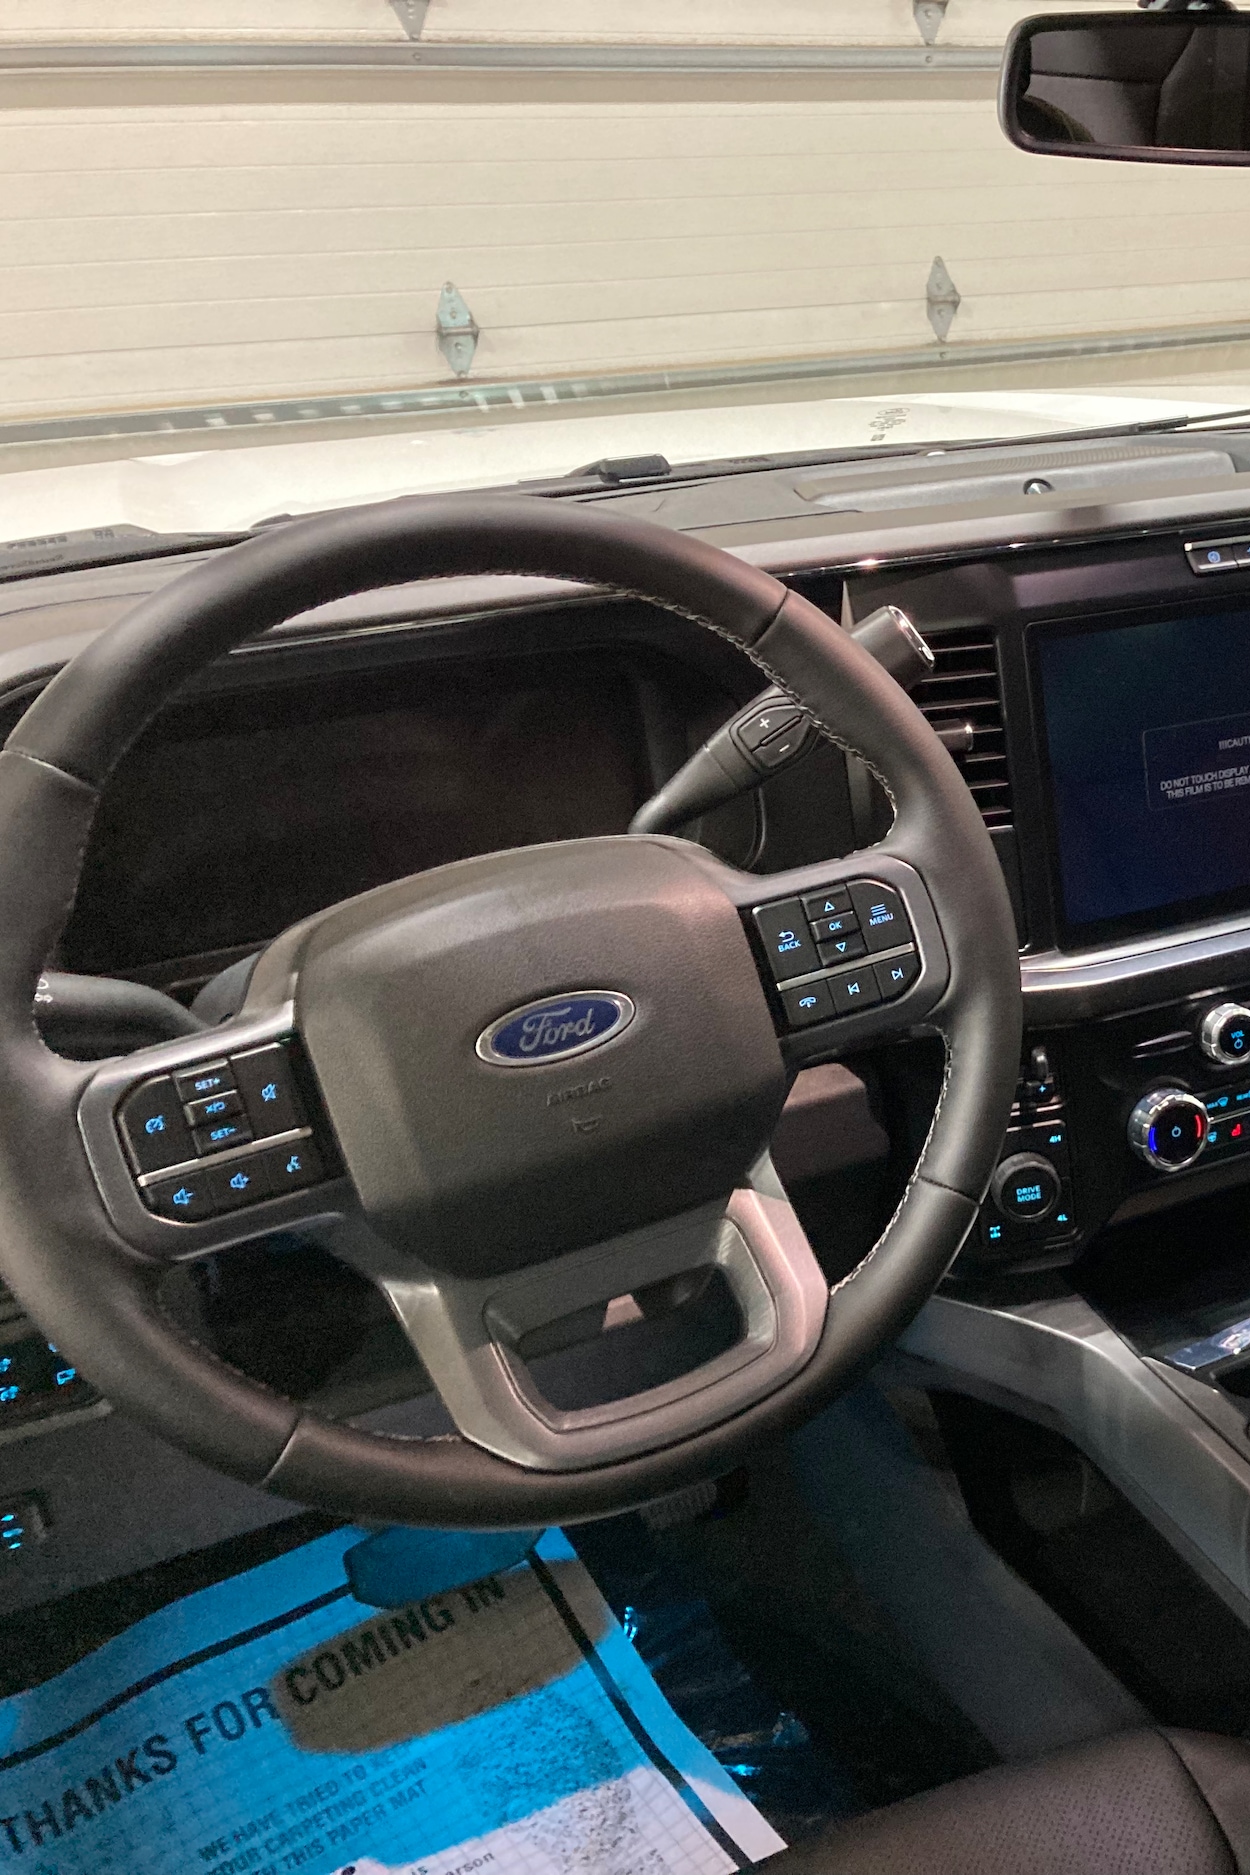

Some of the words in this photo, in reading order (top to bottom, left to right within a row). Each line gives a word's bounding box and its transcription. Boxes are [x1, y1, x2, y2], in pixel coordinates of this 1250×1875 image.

[1160, 781, 1173, 792] DO
[1173, 777, 1189, 788] NOT
[1192, 771, 1219, 785] TOUCH
[1218, 765, 1250, 779] DISPLAY
[1166, 789, 1185, 799] THIS
[1185, 785, 1204, 797] FILM
[1204, 783, 1213, 793] IS
[1213, 781, 1224, 791] TO
[1224, 779, 1234, 789] BE
[828, 921, 843, 931] OK
[869, 913, 894, 926] MENU
[777, 939, 801, 952] BACK
[519, 1006, 596, 1052] Ford
[1230, 1030, 1245, 1039] VOL
[1049, 1134, 1062, 1144] 4H
[1016, 1184, 1041, 1196] DRIVE
[1017, 1191, 1041, 1203] MODE
[0, 1733, 178, 1855] THANKS
[184, 1686, 281, 1755] FOR
[284, 1597, 456, 1706] COMING
[342, 1764, 367, 1784] TO
[369, 1758, 426, 1798] CLEAN
[325, 1803, 387, 1846] PAPER
[388, 1778, 428, 1810] MAT
